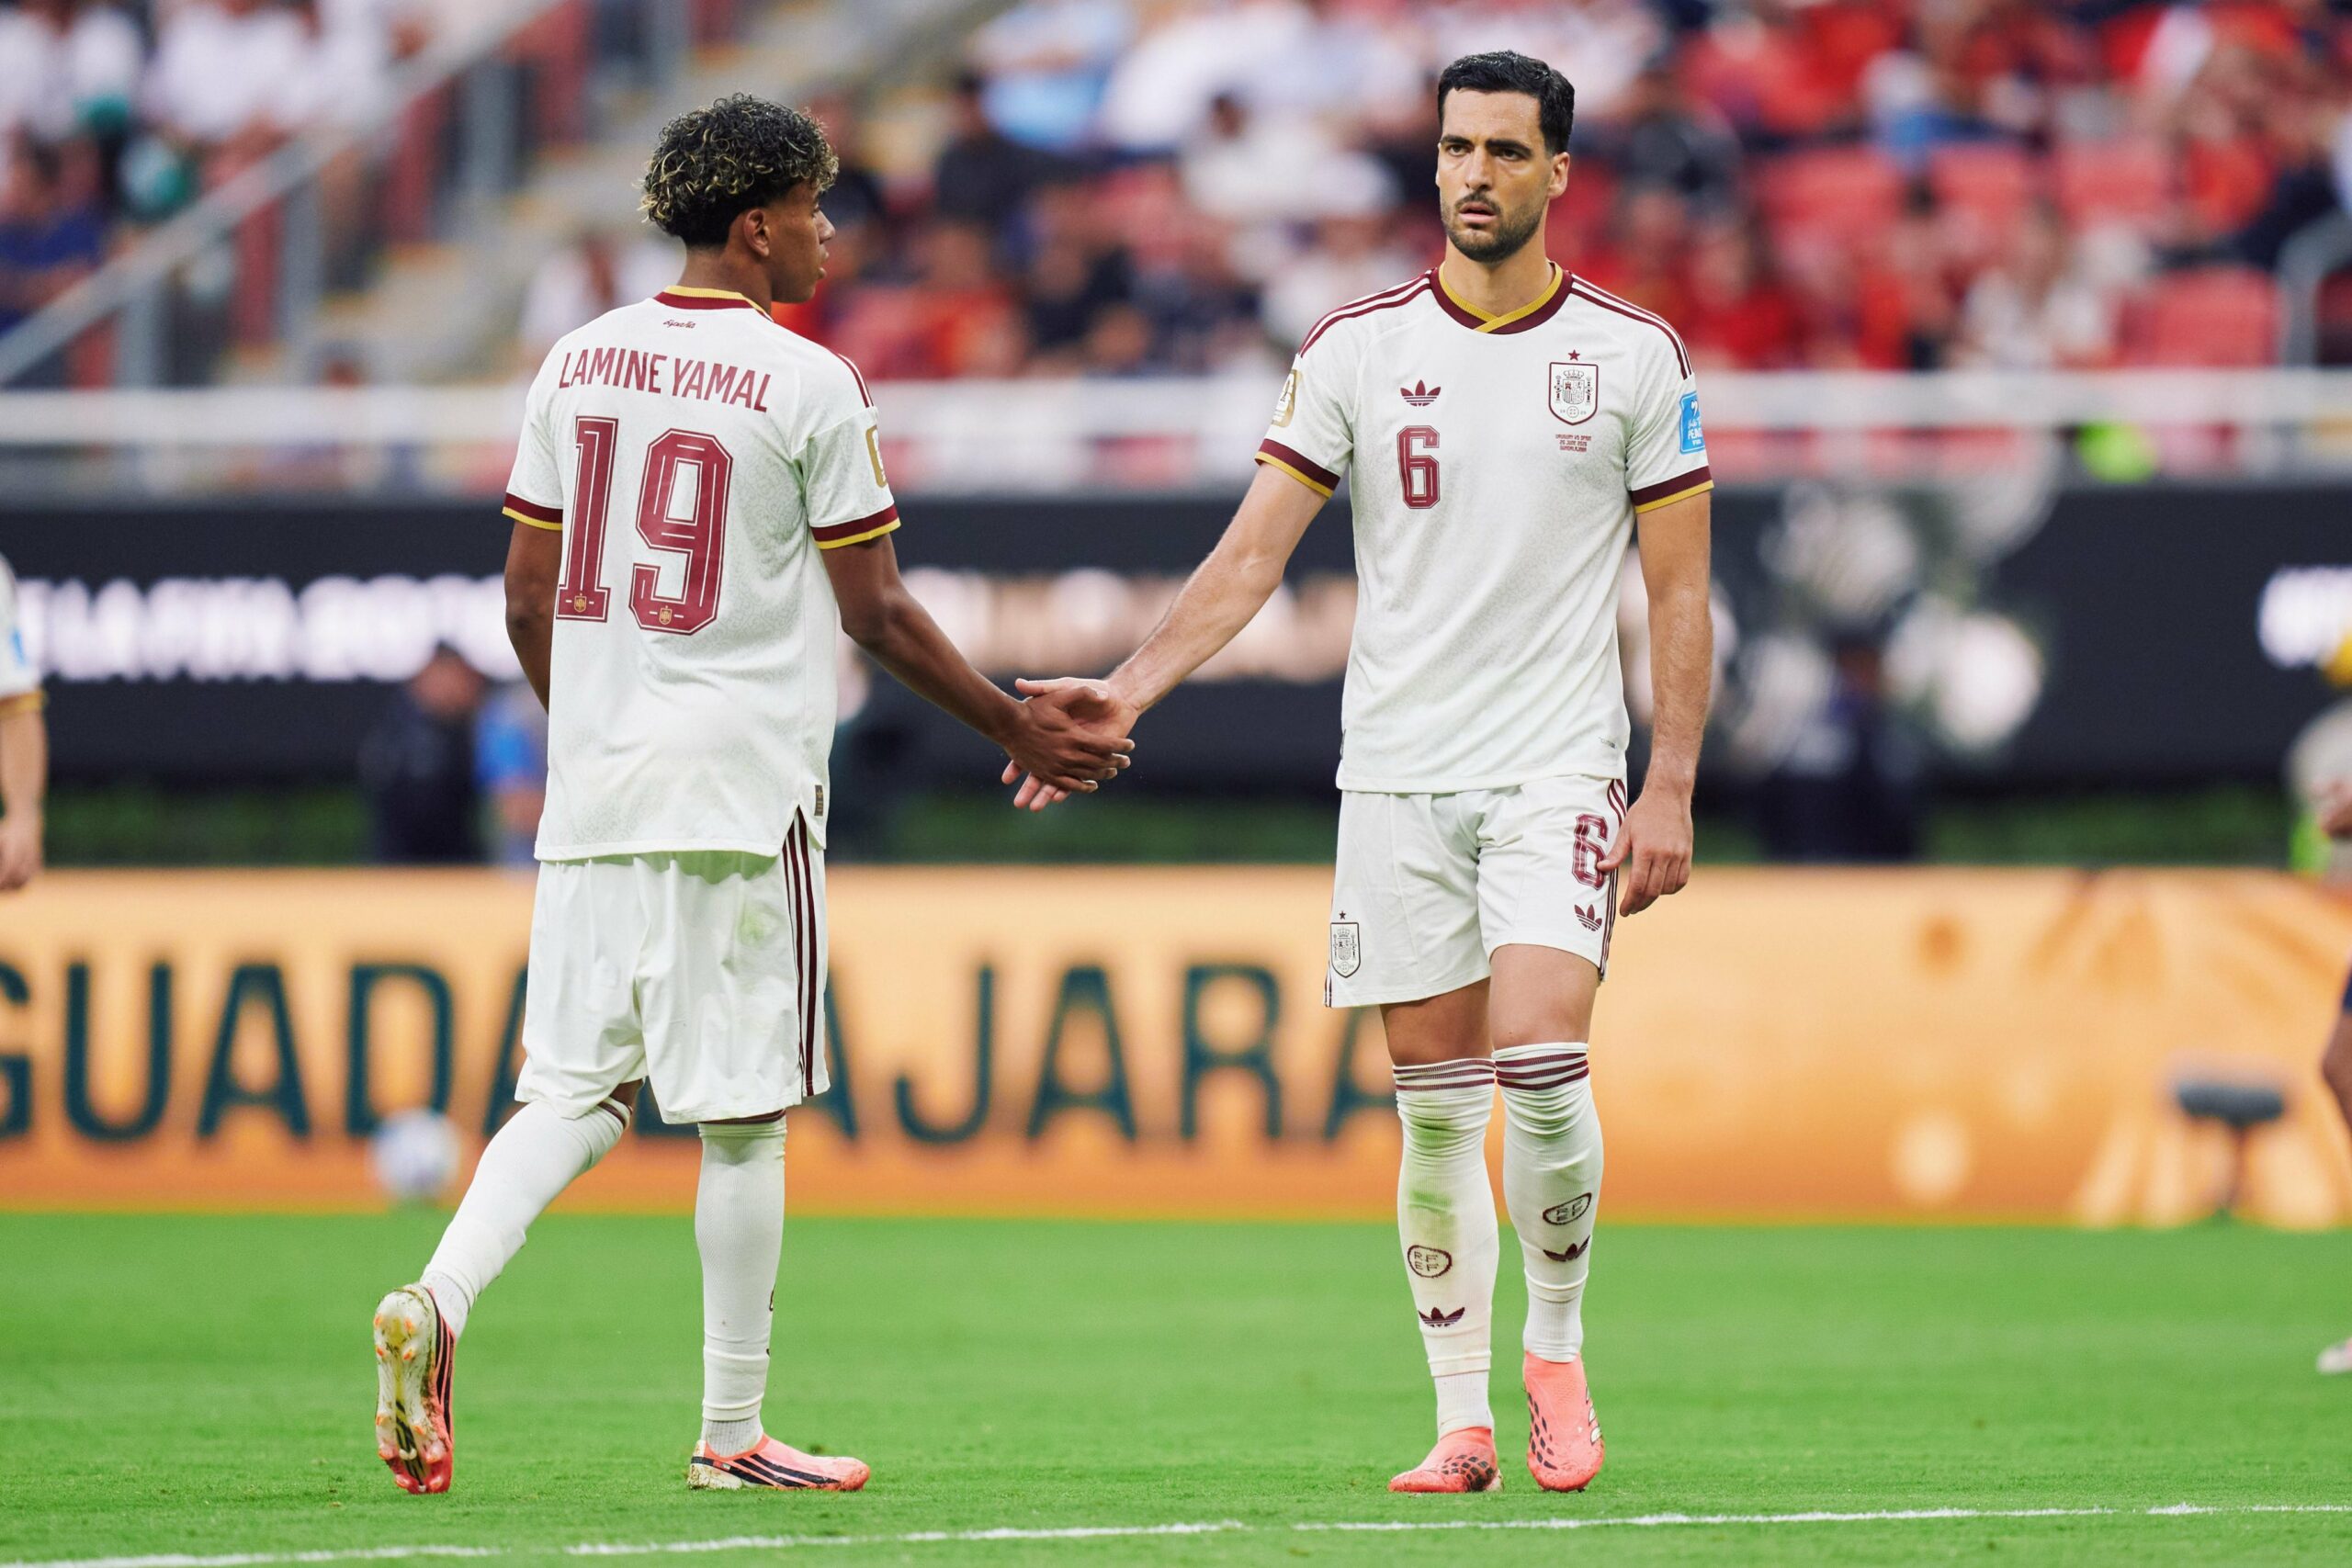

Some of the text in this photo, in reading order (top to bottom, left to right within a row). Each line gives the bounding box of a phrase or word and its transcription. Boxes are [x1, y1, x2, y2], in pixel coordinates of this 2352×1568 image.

[559, 347, 772, 412] LAMINE YAMAL
[1396, 425, 1441, 509] 6
[556, 416, 733, 636] 19
[1572, 814, 1608, 891] 6
